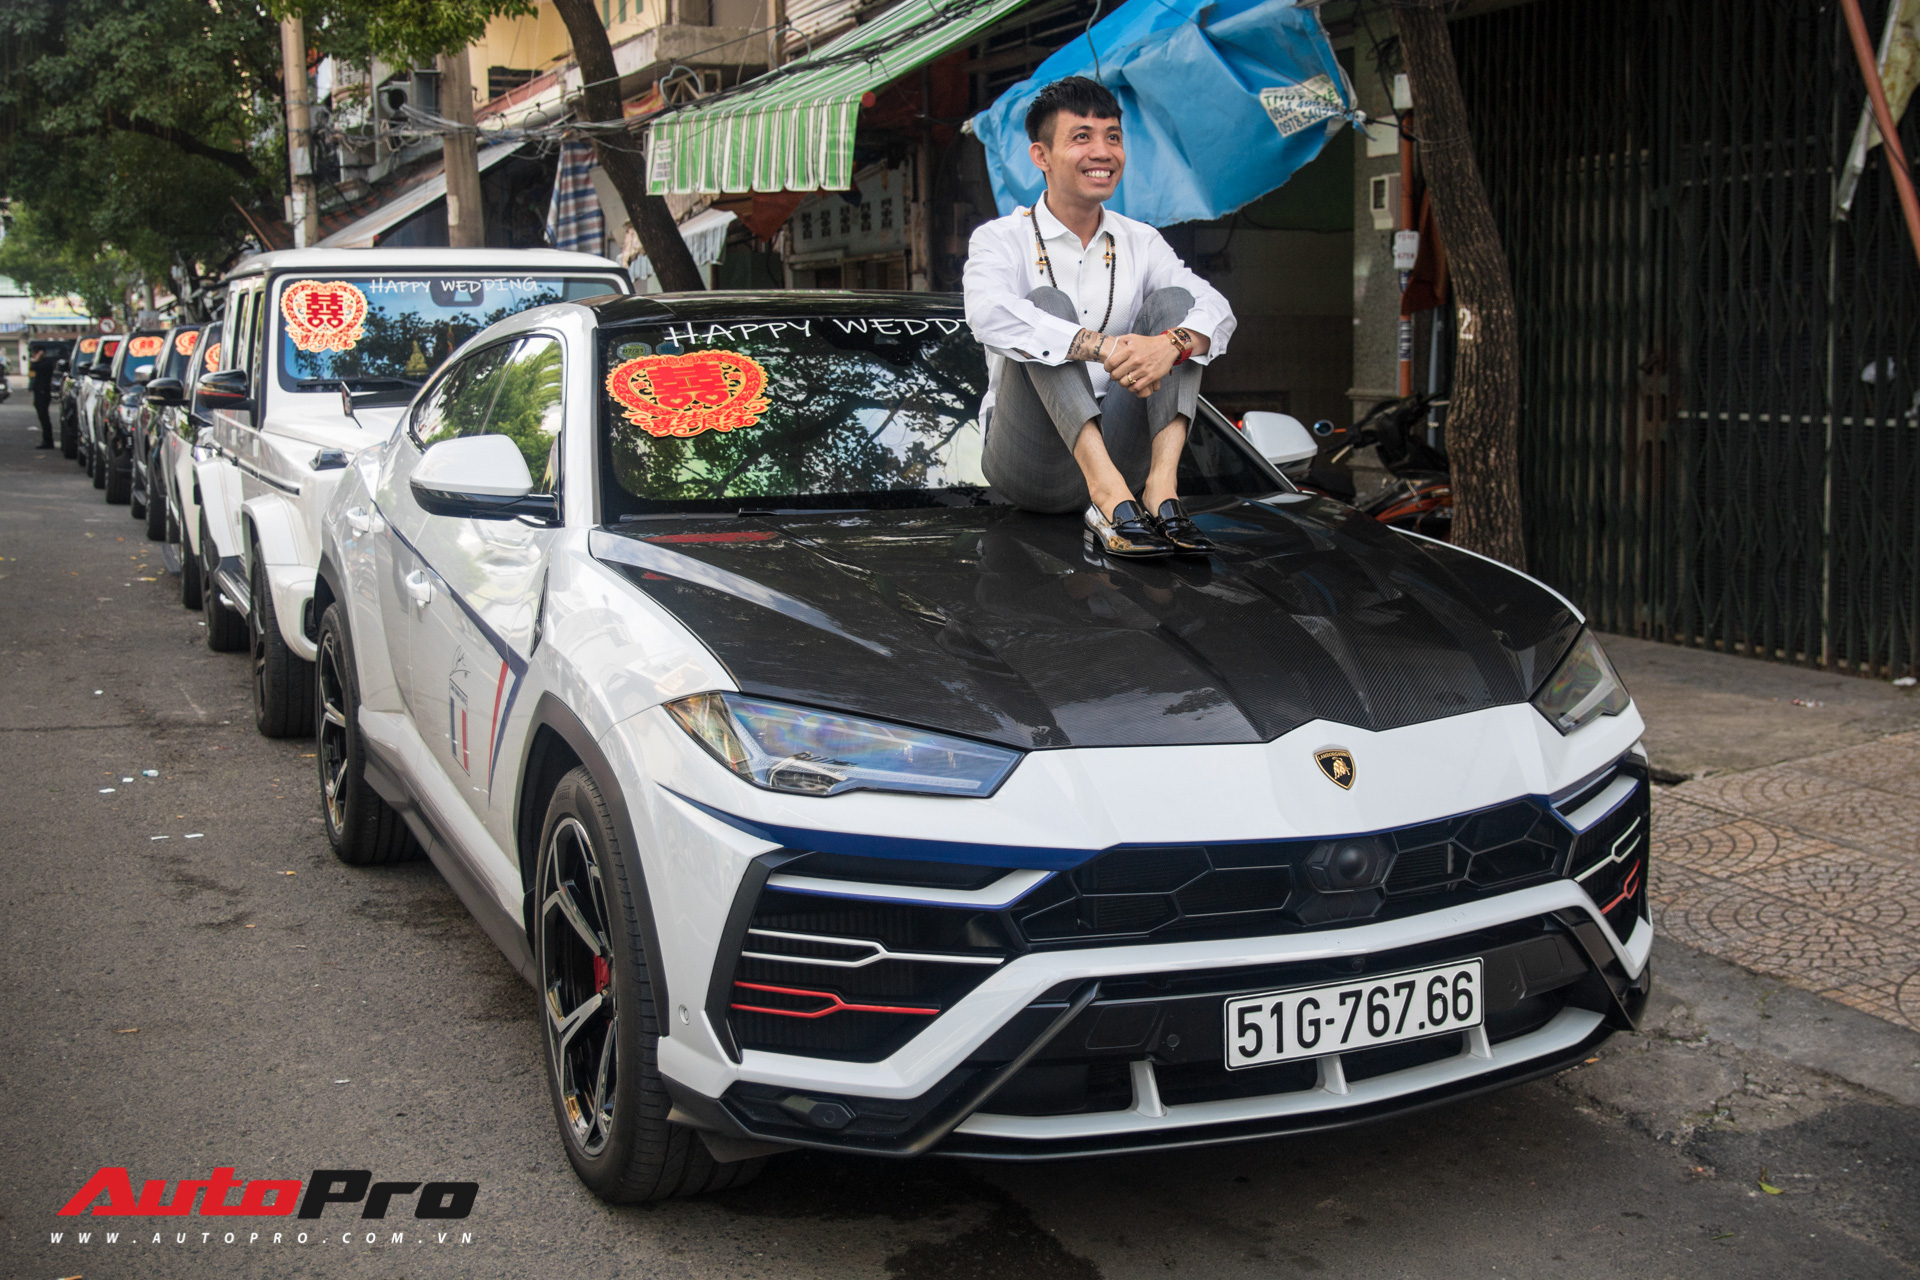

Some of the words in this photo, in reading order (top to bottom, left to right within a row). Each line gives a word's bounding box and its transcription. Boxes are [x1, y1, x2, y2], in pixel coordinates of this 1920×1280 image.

[369, 277, 430, 295] HAPPY
[441, 276, 539, 294] WEDDING
[664, 320, 811, 348] HAPPY
[833, 317, 976, 336] WEDD
[1458, 307, 1474, 340] 2
[1237, 970, 1474, 1059] 51G-767.66
